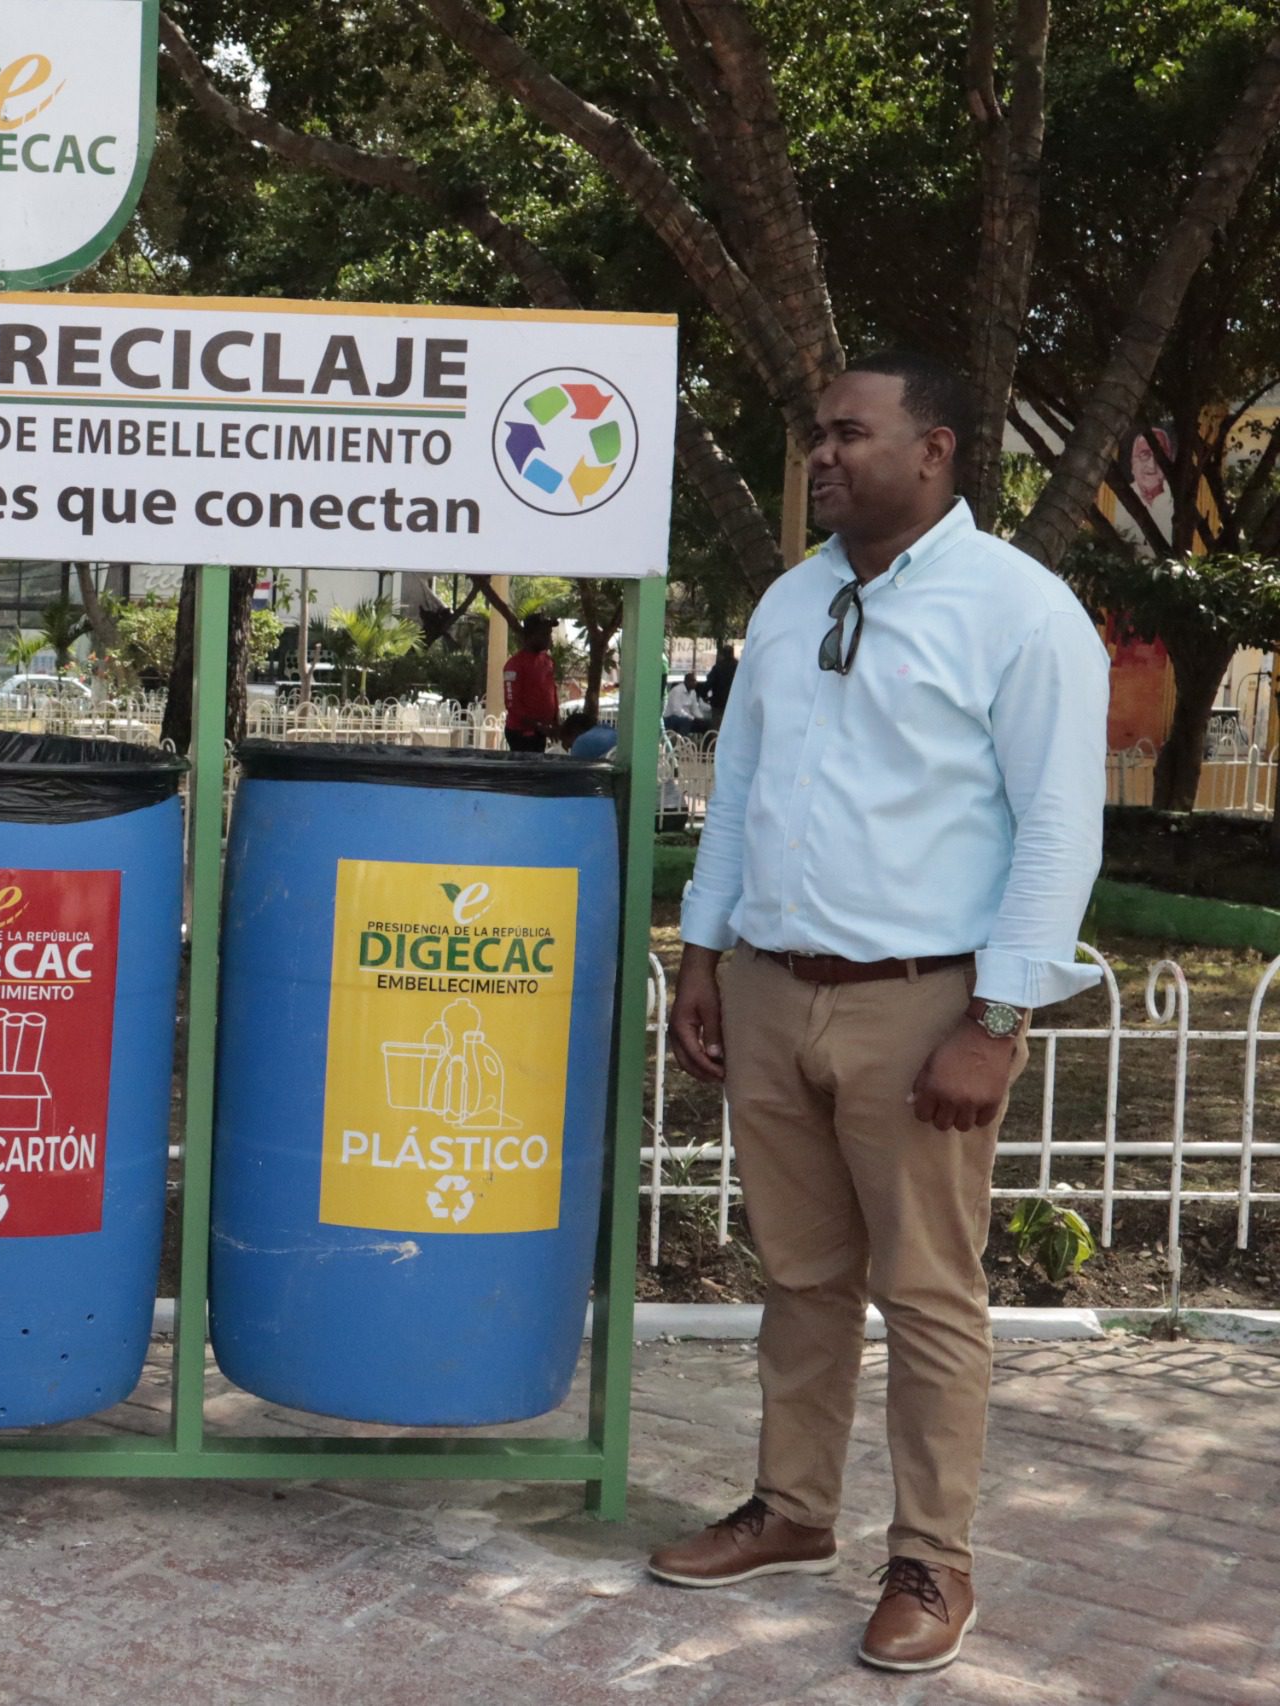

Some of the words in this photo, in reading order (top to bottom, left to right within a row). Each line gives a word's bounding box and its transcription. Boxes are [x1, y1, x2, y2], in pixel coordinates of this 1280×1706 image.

[52, 416, 452, 466] EMBELLECIMIENTO
[57, 486, 177, 536] que
[194, 487, 480, 535] conectan
[7, 931, 22, 941] LA
[26, 929, 91, 942] REPÚBLICA
[367, 921, 450, 935] PRESIDENCIA
[454, 925, 470, 936] DE
[474, 926, 488, 937] LA
[492, 925, 551, 938] REPÚBLICA
[359, 931, 555, 974] DIGECAC
[377, 974, 539, 995] EMBELLECIMIENTO
[341, 1125, 549, 1171] PLÁSTICO
